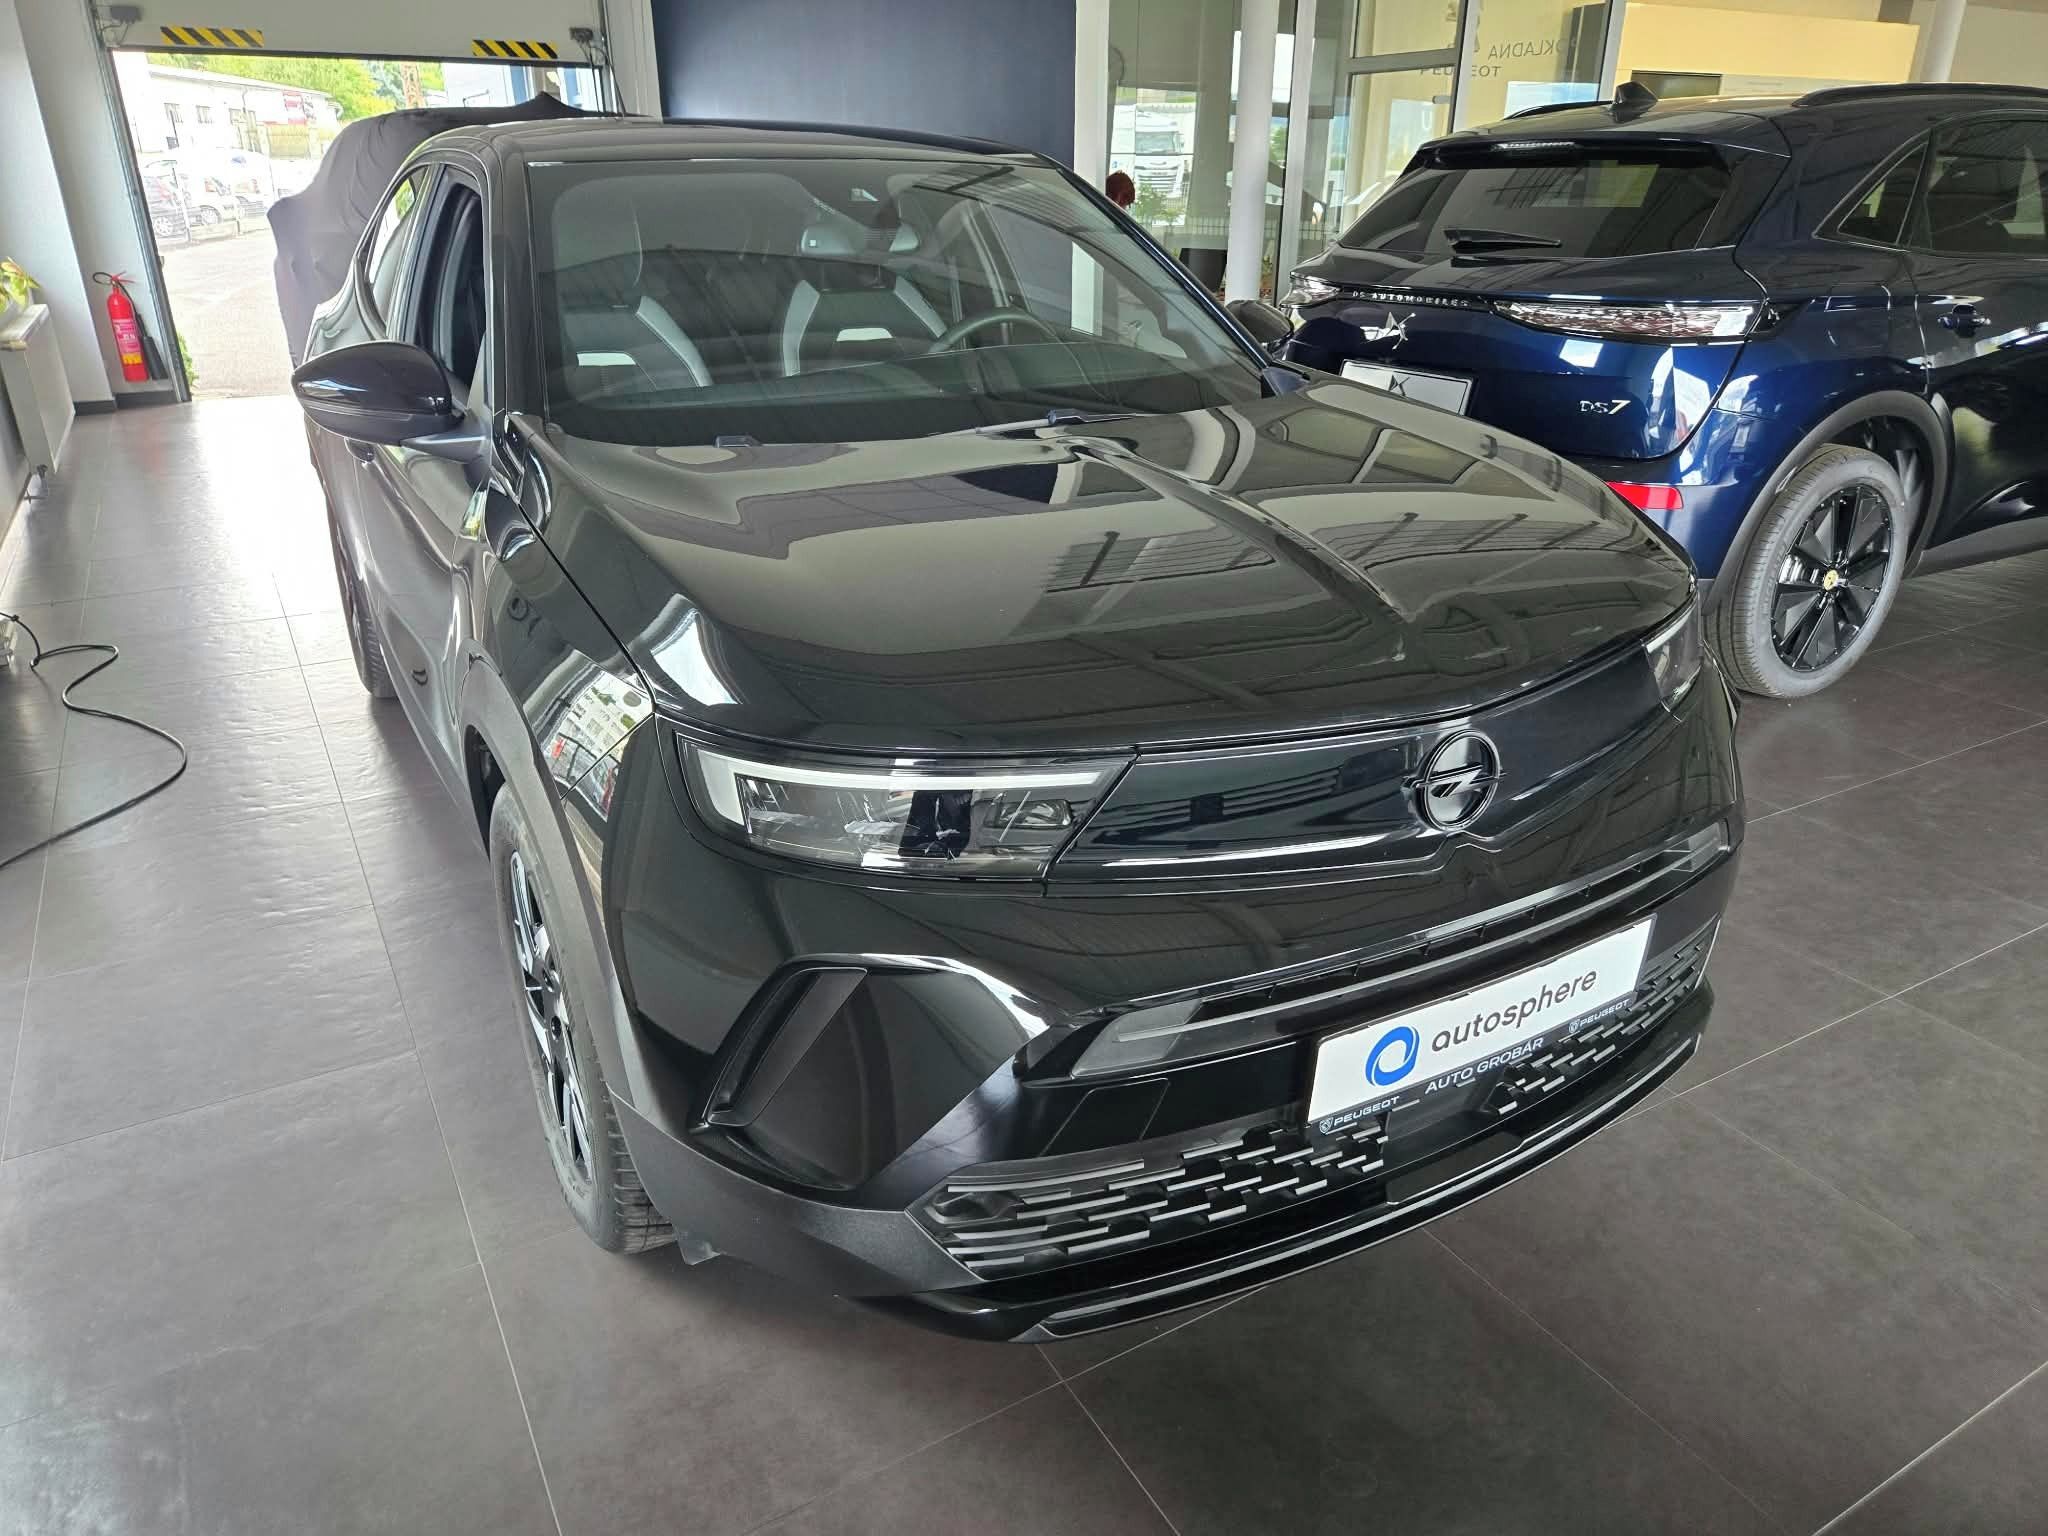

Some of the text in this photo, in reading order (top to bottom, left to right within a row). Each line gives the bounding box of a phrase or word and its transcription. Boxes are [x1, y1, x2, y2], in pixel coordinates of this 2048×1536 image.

[1431, 970, 1597, 1052] autosphere
[1580, 998, 1630, 1027] PEUGEOT
[1424, 1067, 1473, 1095] AUTO
[1333, 1096, 1400, 1126] PEUGEOT
